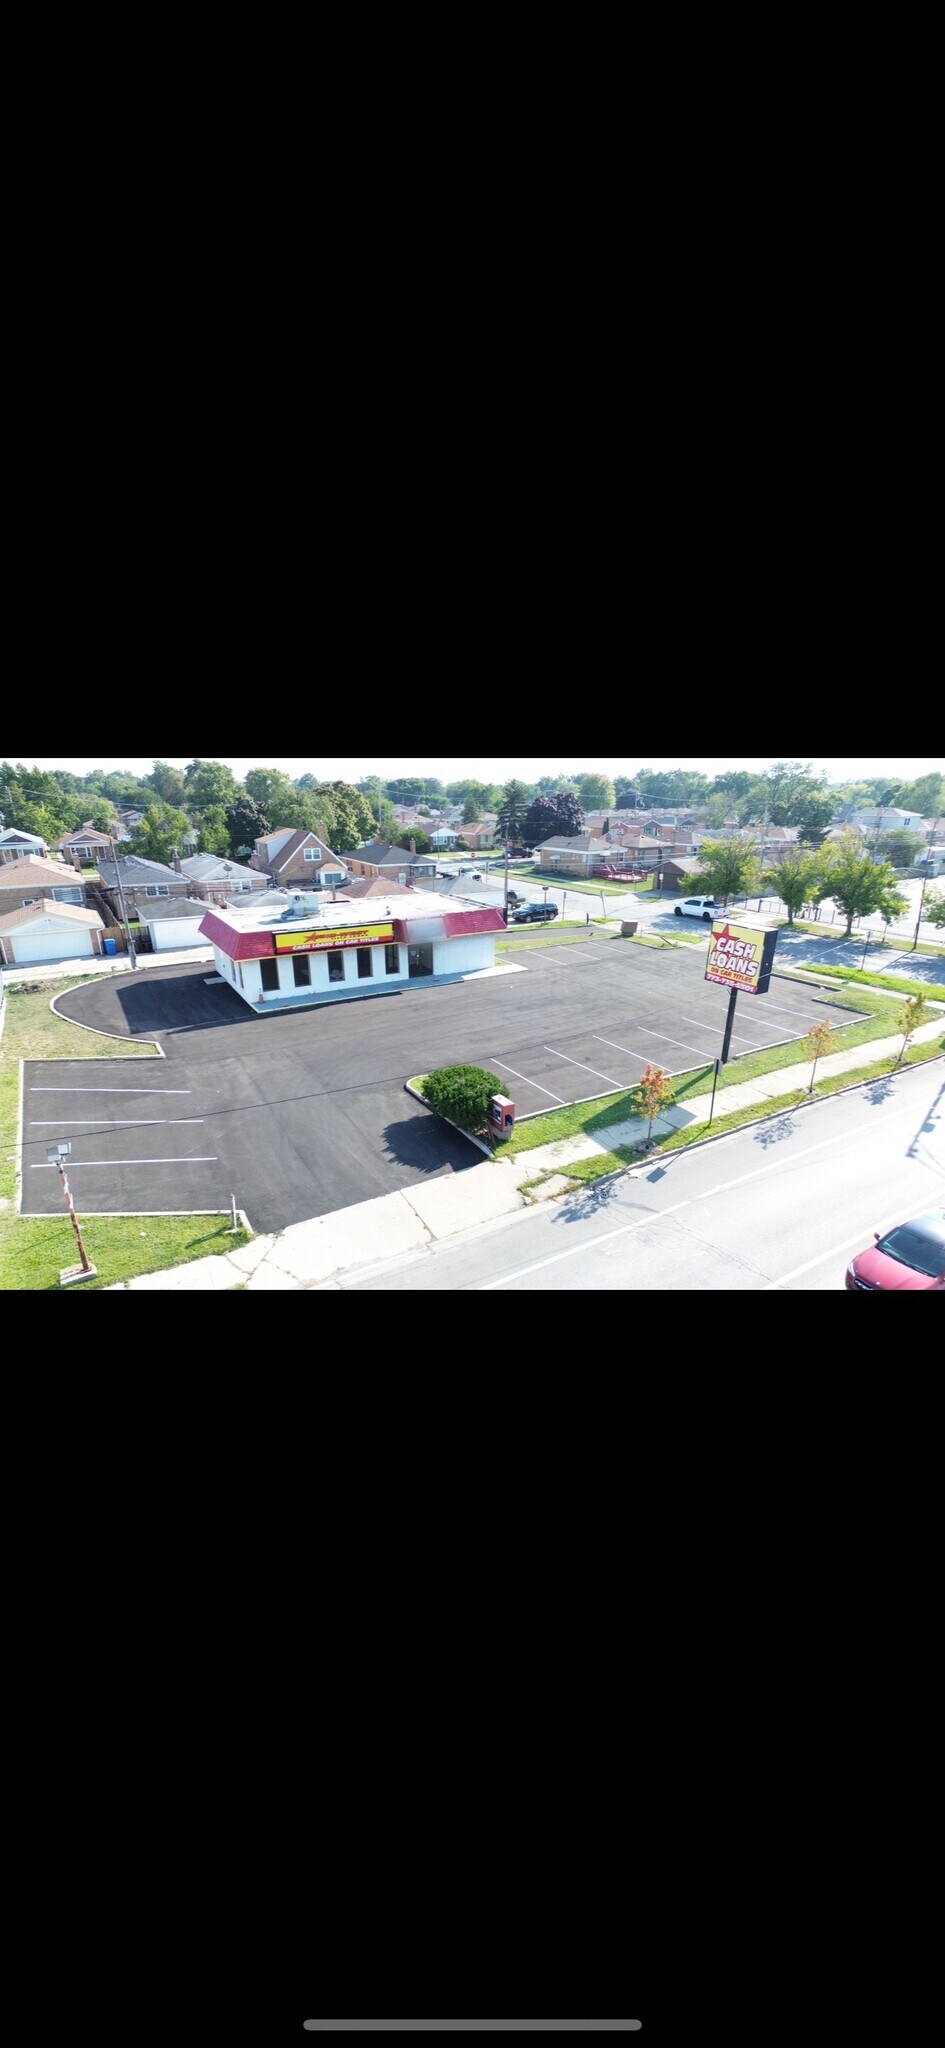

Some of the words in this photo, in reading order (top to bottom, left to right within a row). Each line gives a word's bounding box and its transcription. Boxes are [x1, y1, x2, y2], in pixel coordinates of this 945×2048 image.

[716, 937, 757, 959] CASH
[709, 951, 759, 977] LOANS
[720, 969, 733, 977] CAR
[733, 972, 753, 983] TITLES
